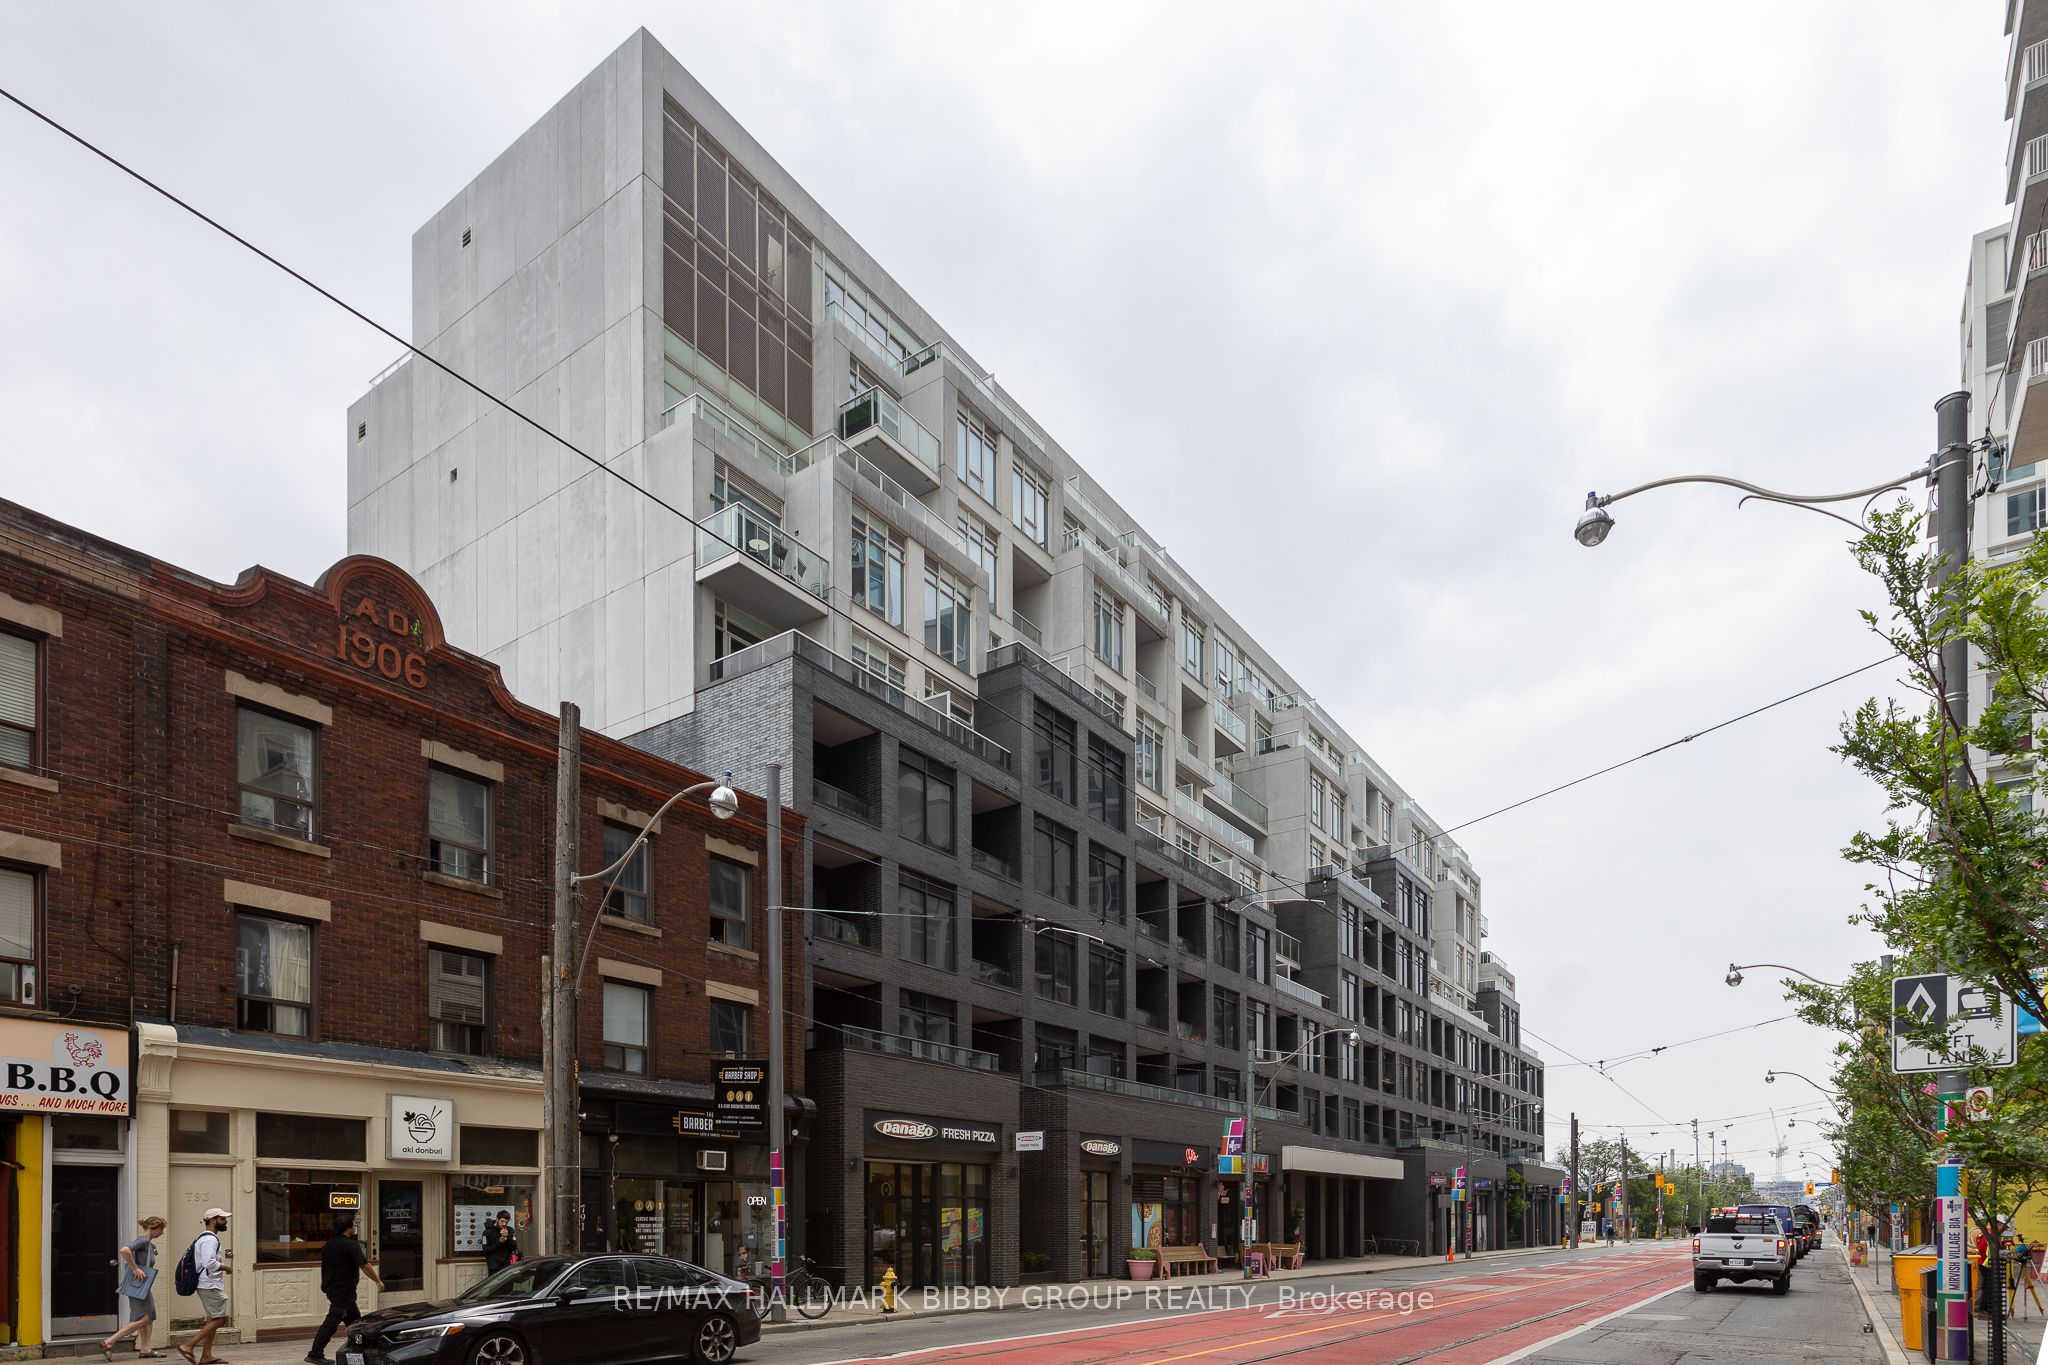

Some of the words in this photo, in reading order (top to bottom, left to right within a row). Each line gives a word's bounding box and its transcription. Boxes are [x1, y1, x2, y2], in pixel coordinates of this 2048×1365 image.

[336, 624, 428, 689] 1906
[6, 1063, 120, 1101] B.B.Q
[724, 1071, 743, 1080] BARBER
[743, 1071, 758, 1080] SHOP
[38, 1097, 61, 1109] AND
[64, 1099, 95, 1111] MUCH
[98, 1101, 127, 1113] MORE
[683, 1116, 714, 1131] BARBER
[882, 1121, 934, 1137] panago
[943, 1127, 971, 1141] FRESH
[972, 1130, 996, 1142] PIZZA
[415, 1147, 442, 1155] donburi
[1086, 1142, 1119, 1154] panago
[332, 1196, 357, 1205] OPEN
[747, 1196, 767, 1206] OPEN
[1949, 1217, 1961, 1229] BIA
[1949, 1232, 1961, 1260] VILLAGE
[1949, 1263, 1961, 1291] MIRVISH
